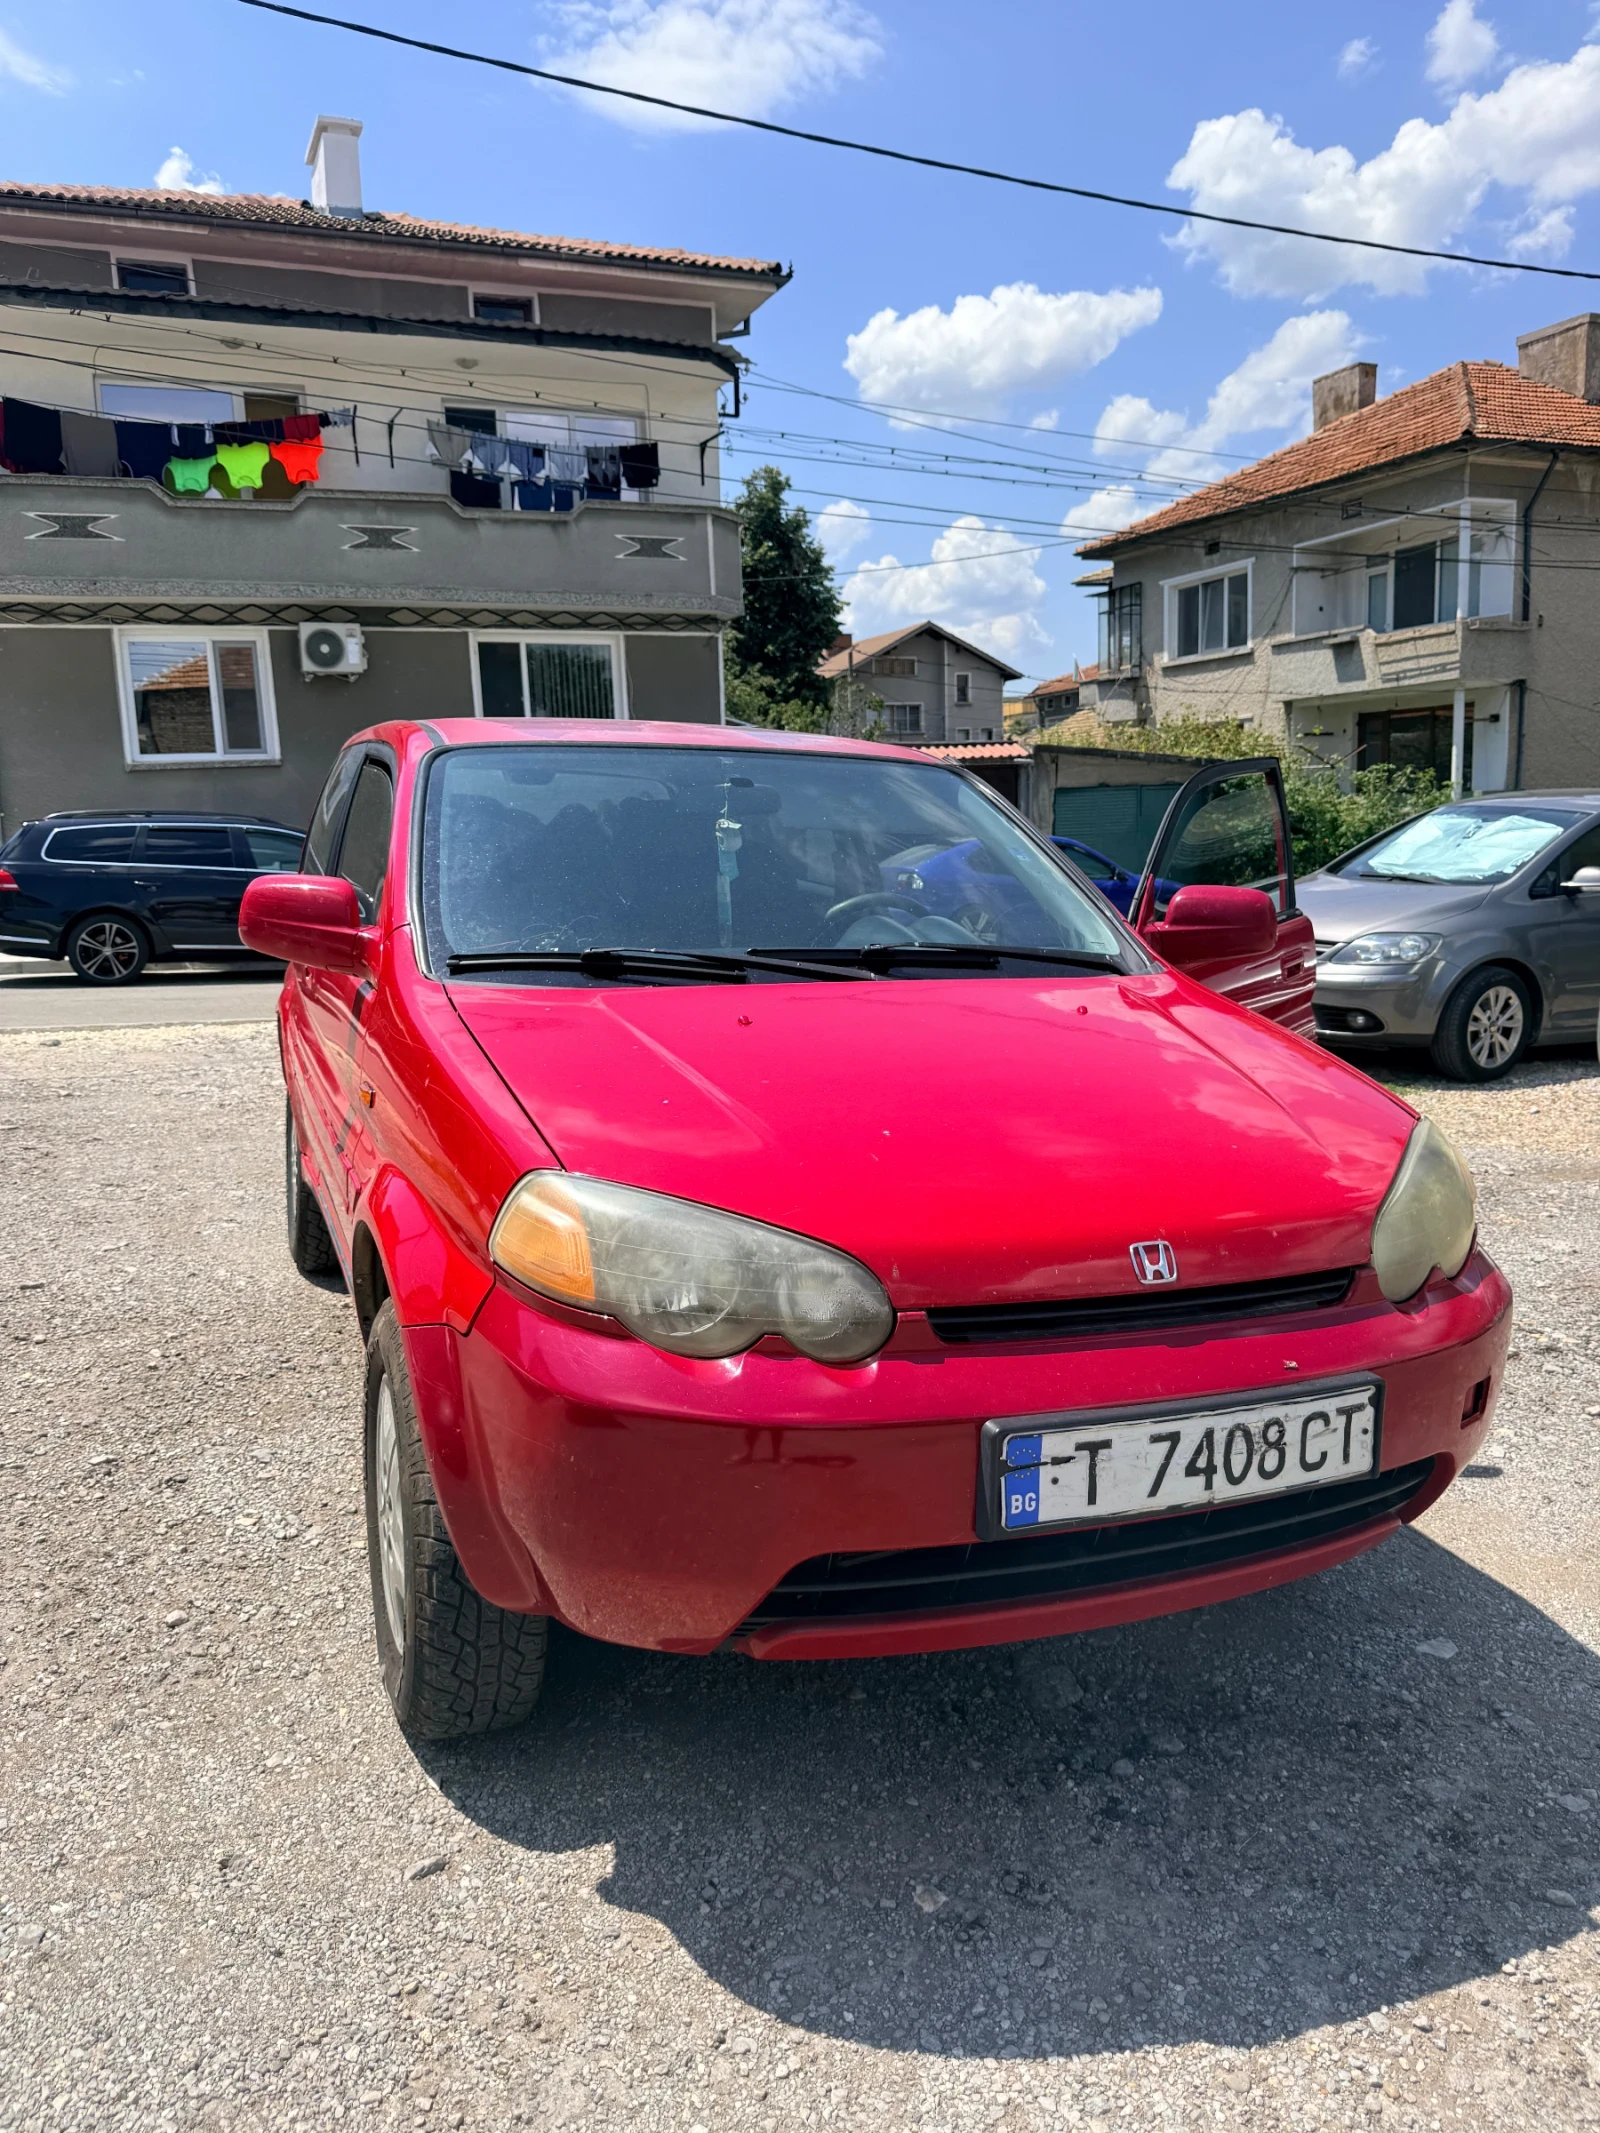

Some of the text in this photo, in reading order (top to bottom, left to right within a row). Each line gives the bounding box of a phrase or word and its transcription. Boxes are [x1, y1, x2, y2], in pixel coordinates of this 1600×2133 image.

[1074, 1402, 1368, 1506] T 7408 CT
[1010, 1492, 1037, 1515] BG
